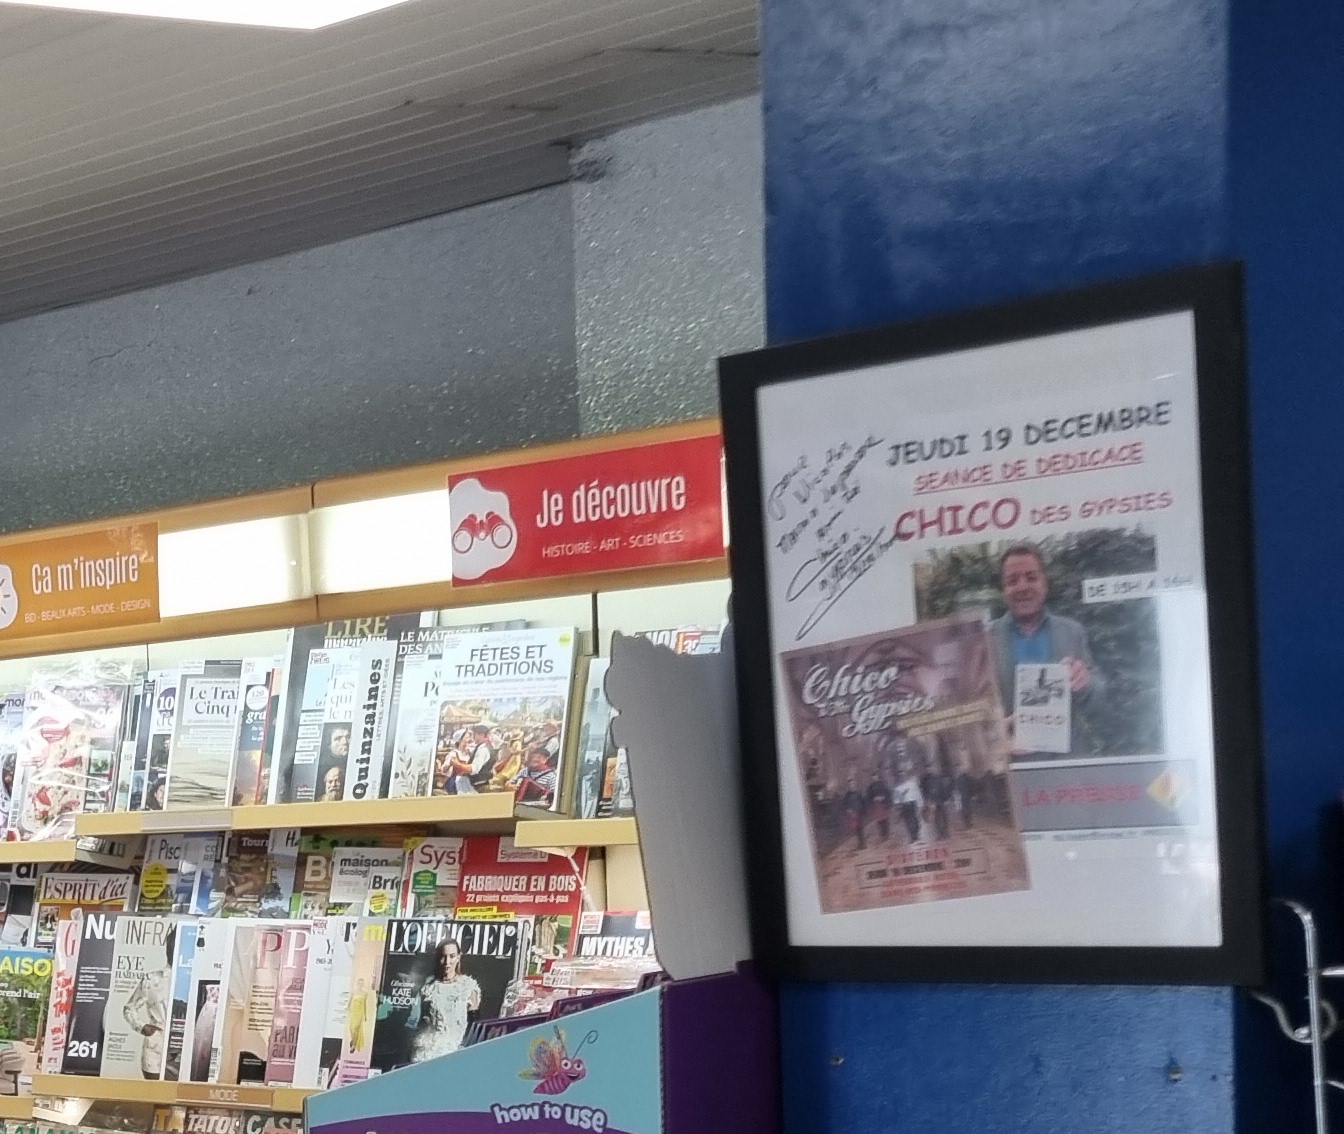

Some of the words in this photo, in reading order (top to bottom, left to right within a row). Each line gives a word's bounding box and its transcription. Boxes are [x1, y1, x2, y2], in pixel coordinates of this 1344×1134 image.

[885, 433, 968, 467] JEUDI
[982, 426, 1012, 451] 19
[1023, 401, 1172, 447] DECEMBRE
[915, 463, 993, 492] SEANCE
[1002, 460, 1027, 479] DE
[1036, 442, 1144, 476] DEDICACE
[536, 489, 564, 528] Je
[572, 475, 686, 523] découvre
[894, 497, 1022, 541] CHICO
[1030, 502, 1070, 526] DES
[1080, 490, 1173, 519] GYPSIES
[542, 543, 591, 558] HISTOIRE
[599, 538, 620, 551] ART
[629, 530, 684, 549] SCIENCES
[57, 551, 139, 592] m'inspire
[470, 647, 519, 663] FÊTES
[525, 644, 547, 660] ET
[454, 660, 554, 679] TRADITIONS
[802, 663, 899, 704] Chico
[352, 658, 383, 801] Quinzaines
[44, 876, 99, 900] ESPRIT
[462, 875, 528, 892] FABRIQUER
[549, 873, 577, 891] BOIS
[581, 936, 644, 957] MYTHES
[67, 1041, 98, 1059] 261
[490, 1103, 538, 1124] how
[543, 1103, 562, 1122] to
[565, 1104, 609, 1132] use
